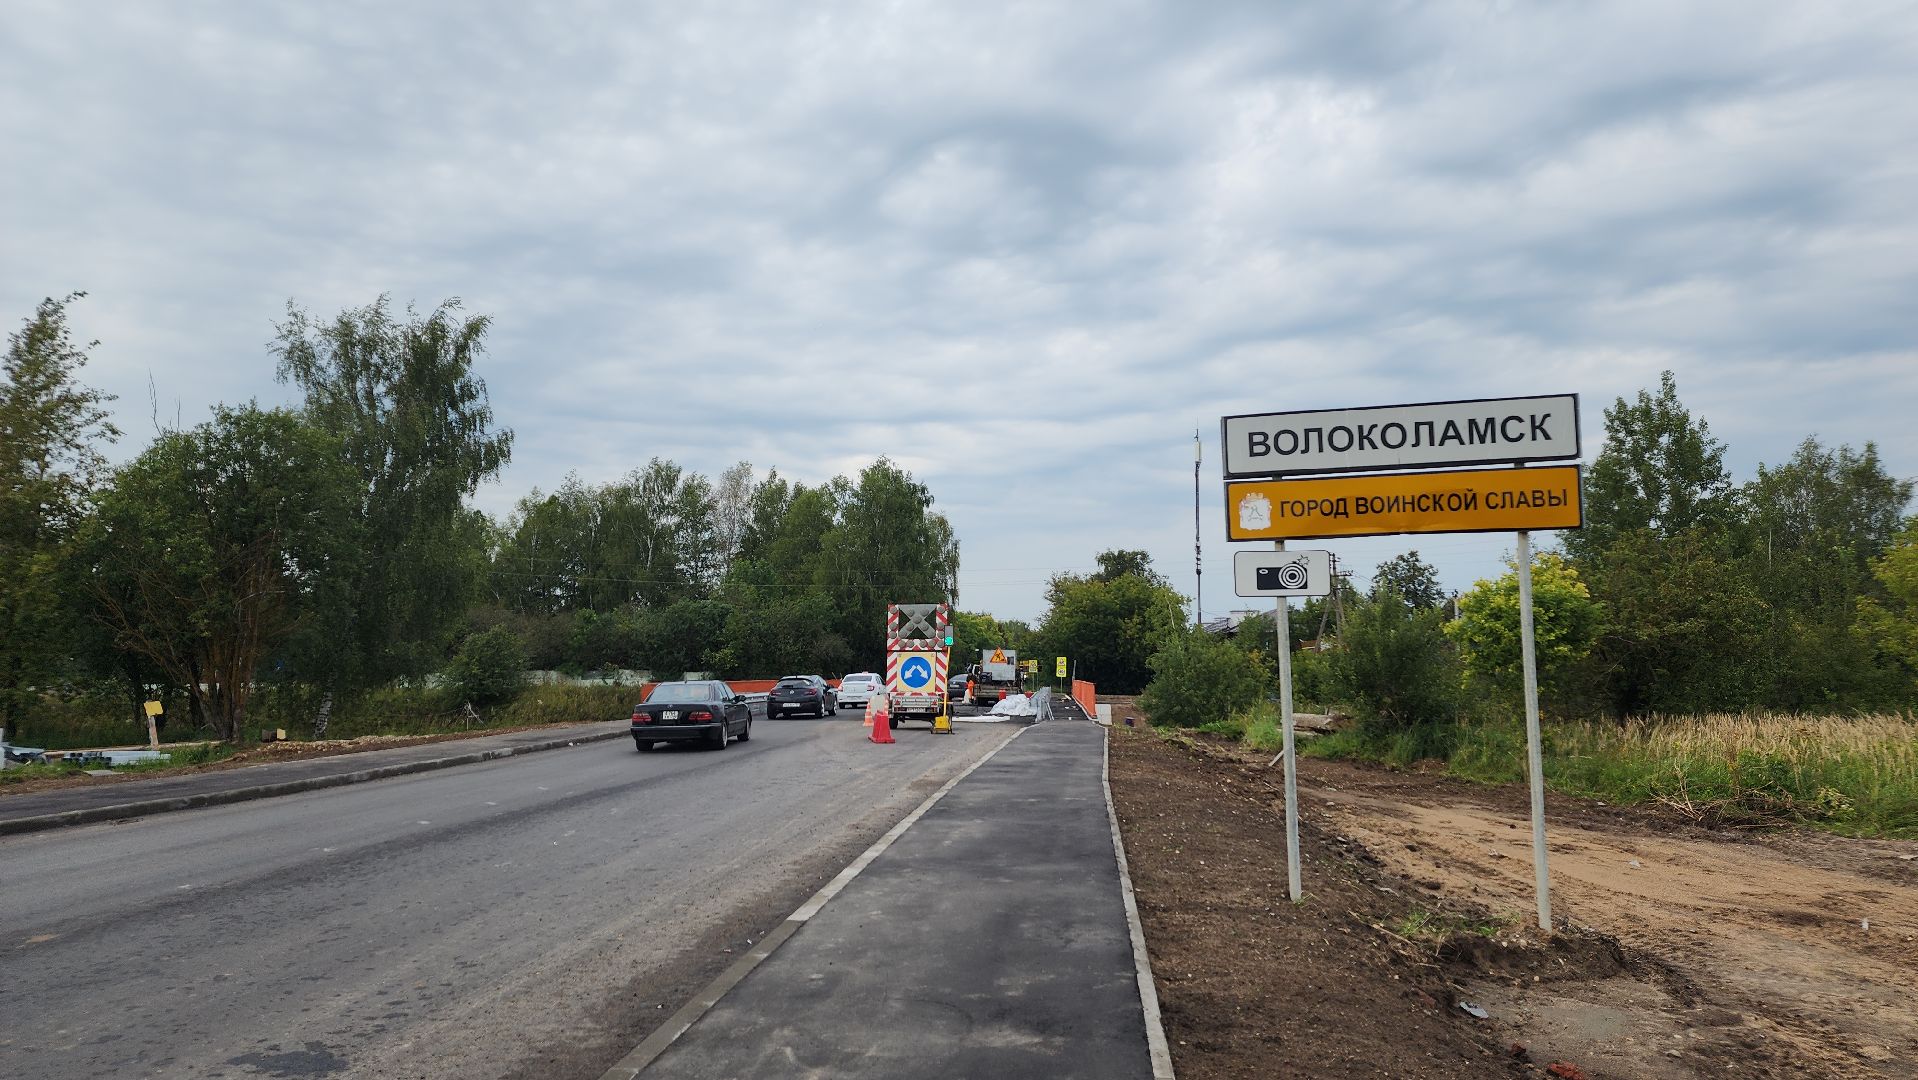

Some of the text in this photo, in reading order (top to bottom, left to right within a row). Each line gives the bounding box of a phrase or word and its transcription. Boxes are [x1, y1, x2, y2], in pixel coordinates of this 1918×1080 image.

[1248, 413, 1552, 458] ВОЛОКОЛАМСК
[1280, 489, 1568, 518] ГОРОД ВОИНСКОЙ СЛАВЫ
